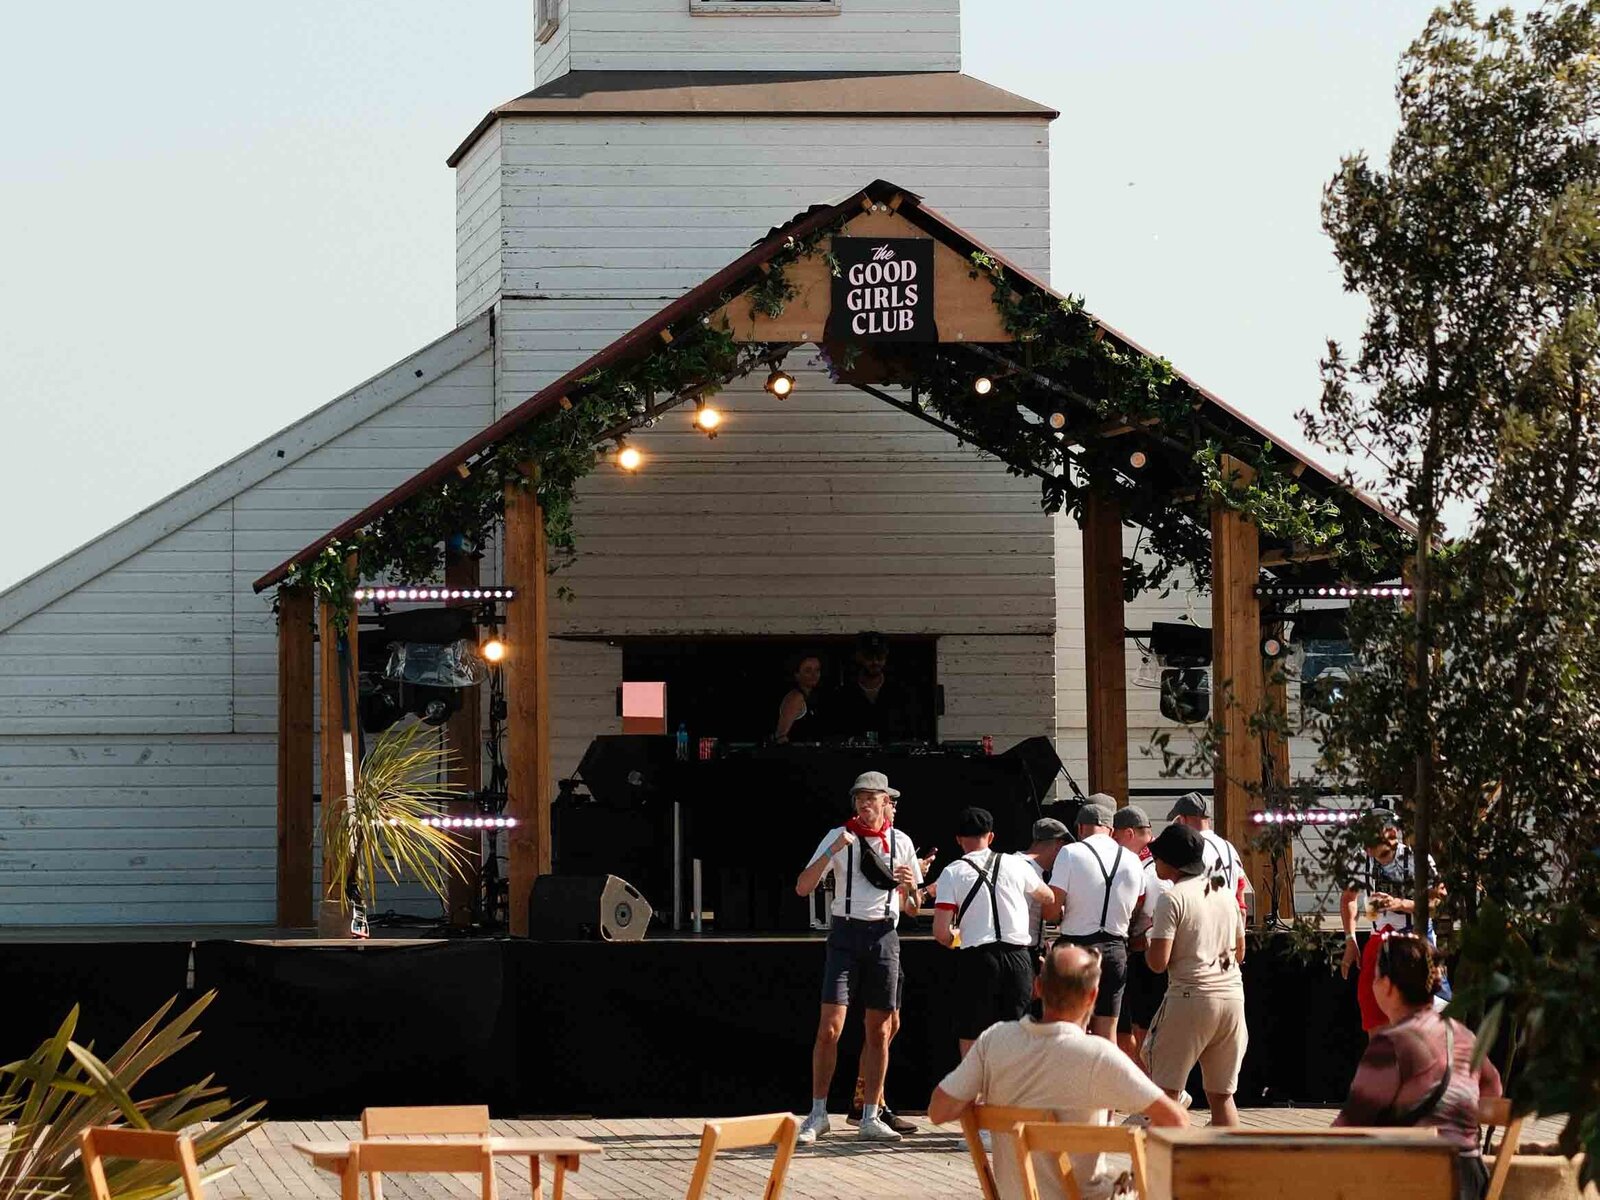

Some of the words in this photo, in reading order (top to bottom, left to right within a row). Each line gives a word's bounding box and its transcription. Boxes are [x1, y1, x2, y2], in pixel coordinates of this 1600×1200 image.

[848, 260, 917, 286] GOOD
[847, 284, 918, 311] GIRLS
[852, 309, 914, 335] CLUB
